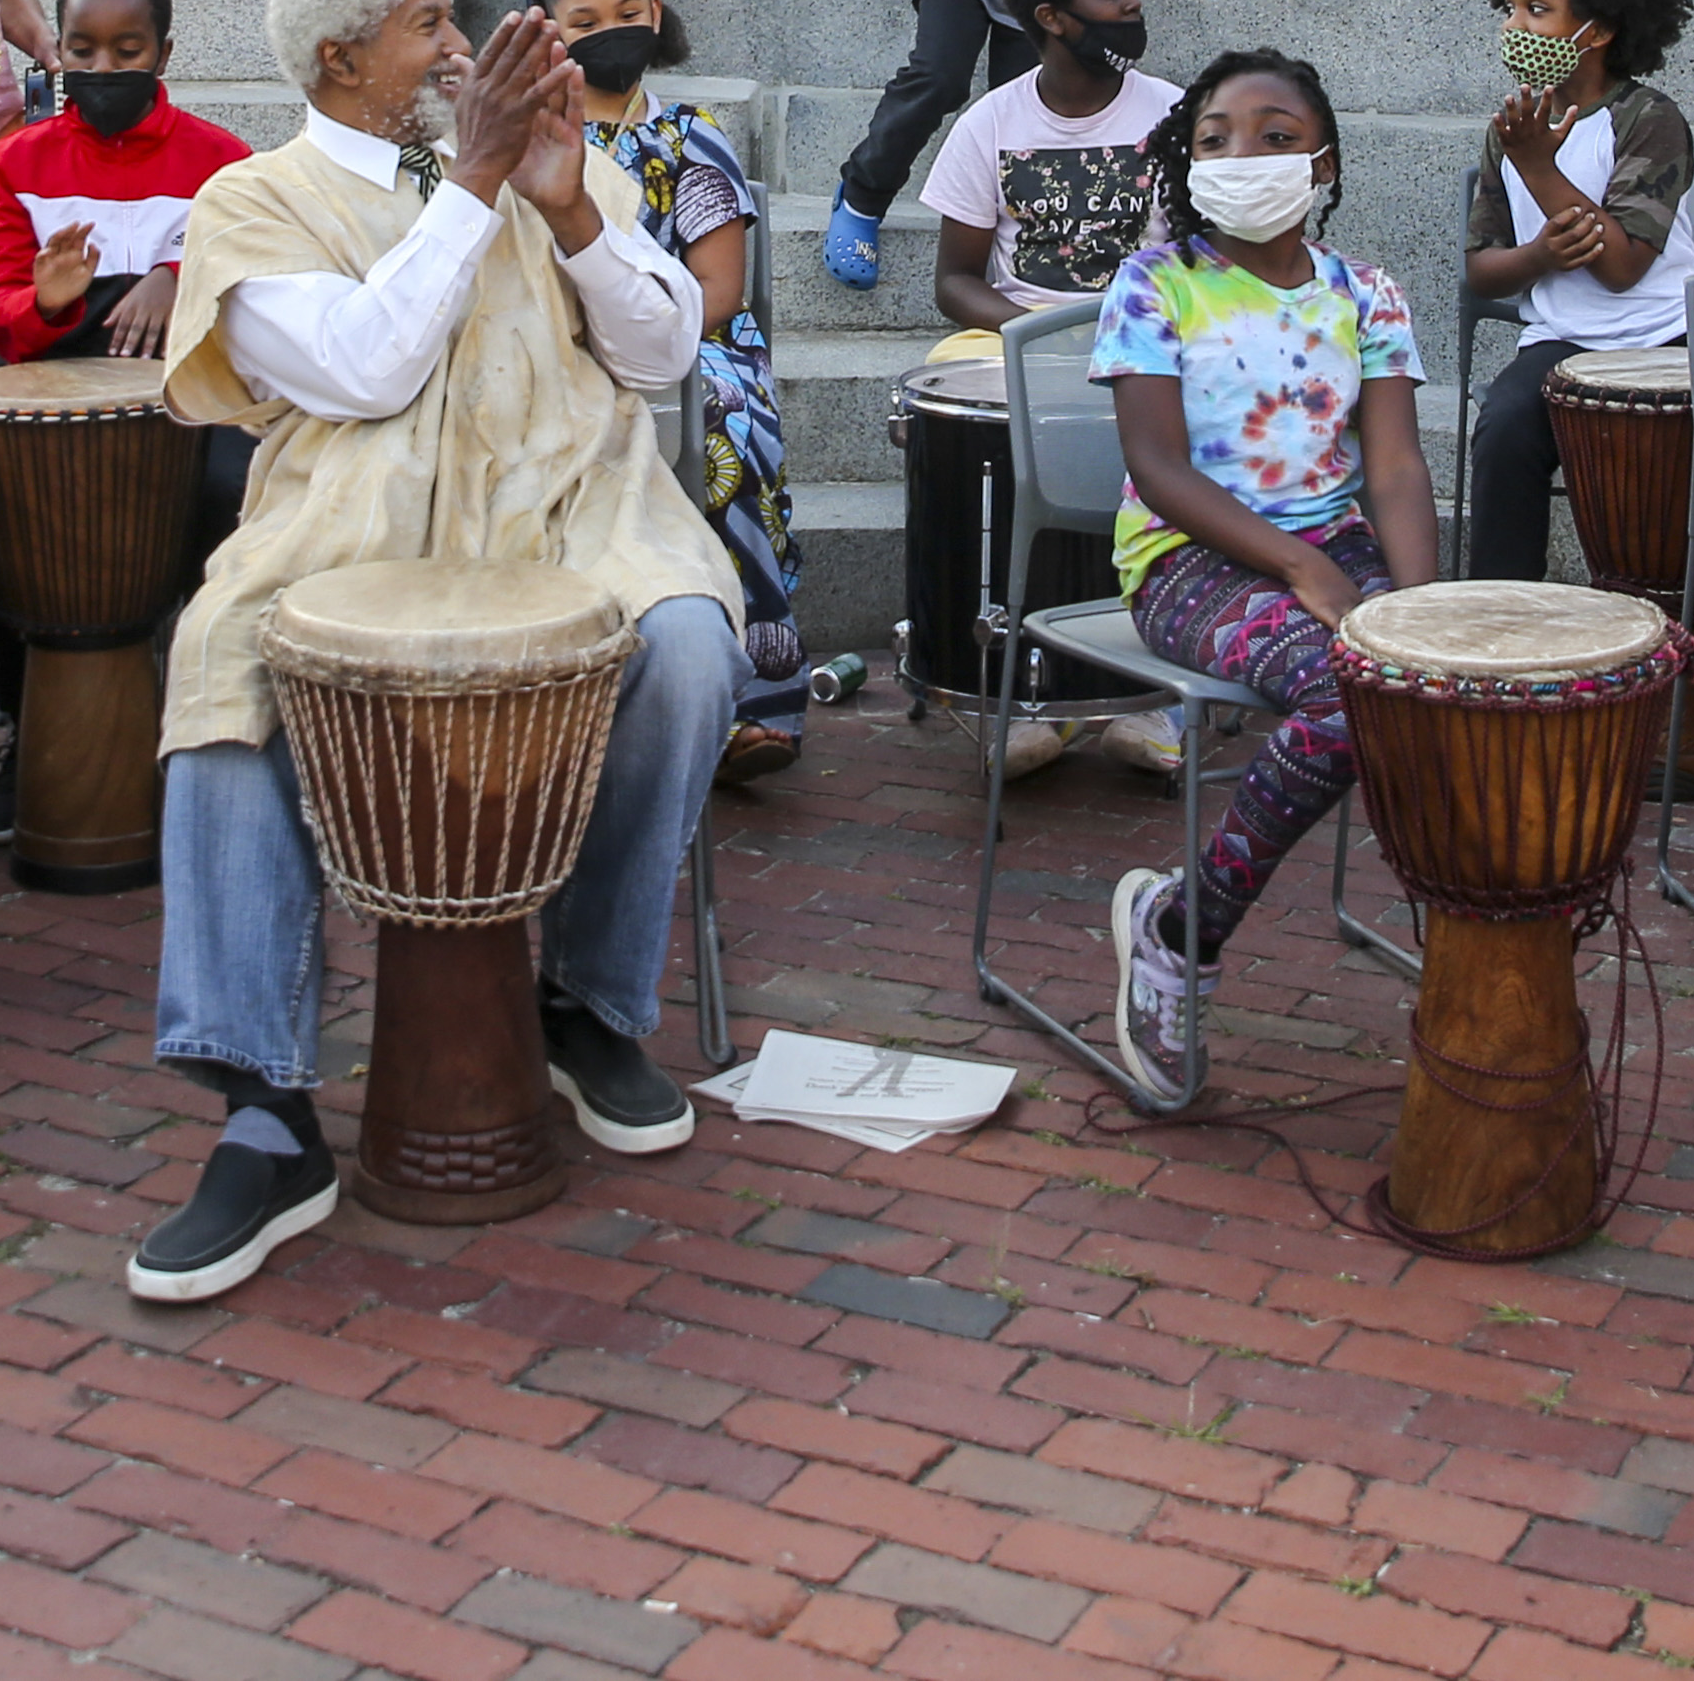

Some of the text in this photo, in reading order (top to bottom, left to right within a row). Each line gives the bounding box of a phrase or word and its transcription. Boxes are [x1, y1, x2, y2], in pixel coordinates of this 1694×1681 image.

[1016, 195, 1144, 214] YOU CAN
[1048, 218, 1093, 235] AVE
